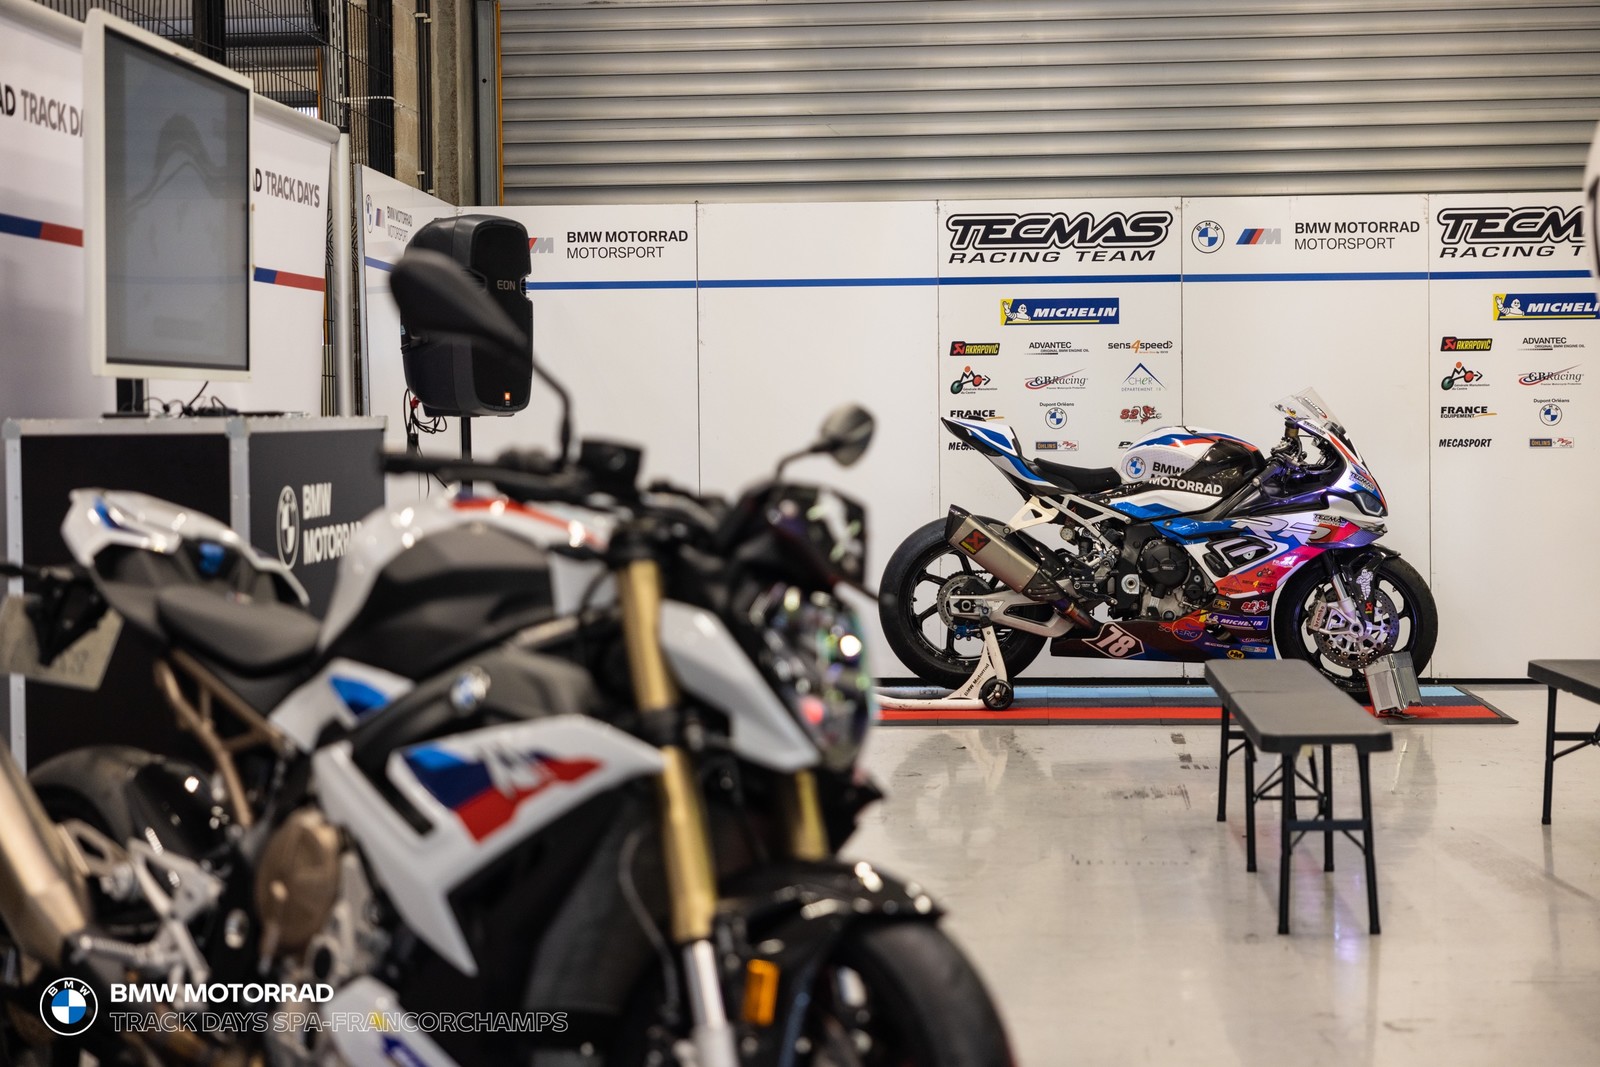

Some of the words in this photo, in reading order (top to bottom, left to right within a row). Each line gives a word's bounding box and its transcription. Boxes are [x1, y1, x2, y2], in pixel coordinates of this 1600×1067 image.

[21, 89, 67, 134] TRACK
[265, 170, 296, 202] TRACK
[297, 179, 320, 208] DAYS
[395, 209, 413, 227] MOTORRAD
[946, 211, 1173, 250] TECMAS
[1295, 222, 1331, 234] BMW
[1334, 221, 1420, 234] MOTORRAD
[1437, 206, 1586, 244] TECM
[567, 231, 602, 243] BMW
[605, 230, 688, 243] MOTORRAD
[1294, 238, 1396, 250] MOTORSPORT
[566, 246, 664, 259] MOTORSPORT
[949, 251, 1061, 264] RACING
[1076, 250, 1156, 263] TEAM
[1439, 246, 1556, 258] RACING
[1571, 245, 1586, 257] T
[497, 280, 516, 290] EON
[1033, 307, 1117, 318] MICHELIN
[1526, 303, 1600, 313] MICHELI
[1028, 341, 1072, 349] ADVANTEC
[1108, 340, 1169, 354] sens4speed
[1522, 337, 1567, 345] ADVANTEC
[1034, 376, 1087, 387] GBRacing
[1528, 371, 1583, 382] GBRacing
[950, 409, 996, 418] FRANCE
[1441, 406, 1488, 414] FRANCE
[1438, 438, 1492, 448] MECASPORT
[1153, 462, 1185, 474] BMW
[1149, 475, 1223, 495] MOTORRAD
[302, 482, 332, 520] BMW
[1096, 625, 1136, 657] 78
